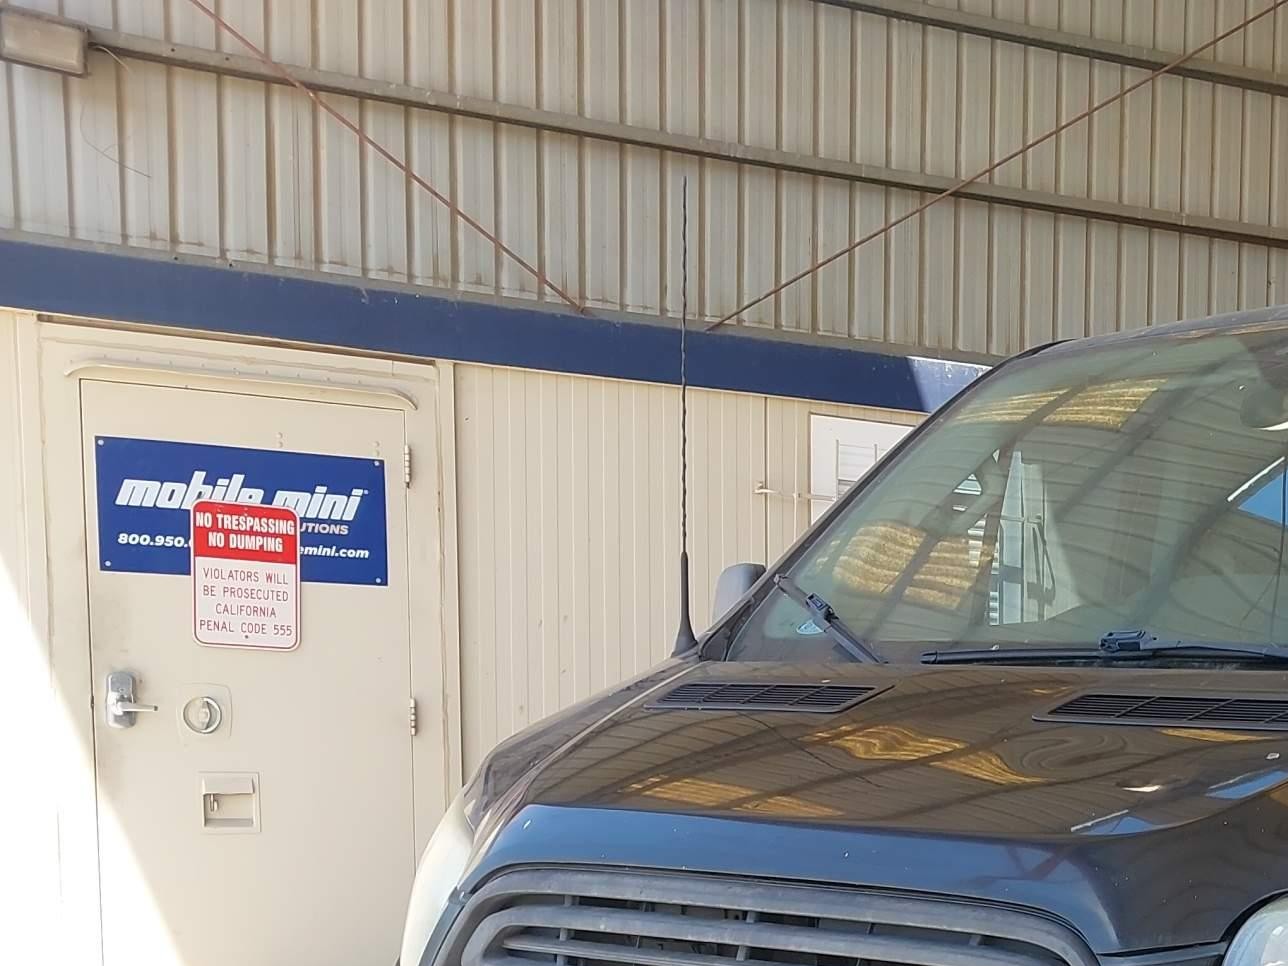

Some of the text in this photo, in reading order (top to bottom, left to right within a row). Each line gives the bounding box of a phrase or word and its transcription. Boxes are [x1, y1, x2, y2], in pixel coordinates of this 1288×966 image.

[115, 471, 363, 520] mobile mini
[195, 512, 295, 535] NO TRESPASSING
[117, 533, 192, 548] 800.950.
[208, 532, 283, 552] NO DUMPING
[203, 568, 288, 585] VIOLATORS WILL
[202, 585, 289, 602] BE PROSECUTED
[216, 603, 277, 618] CALIFORNIA
[200, 620, 293, 636] PENAL CODE 555
